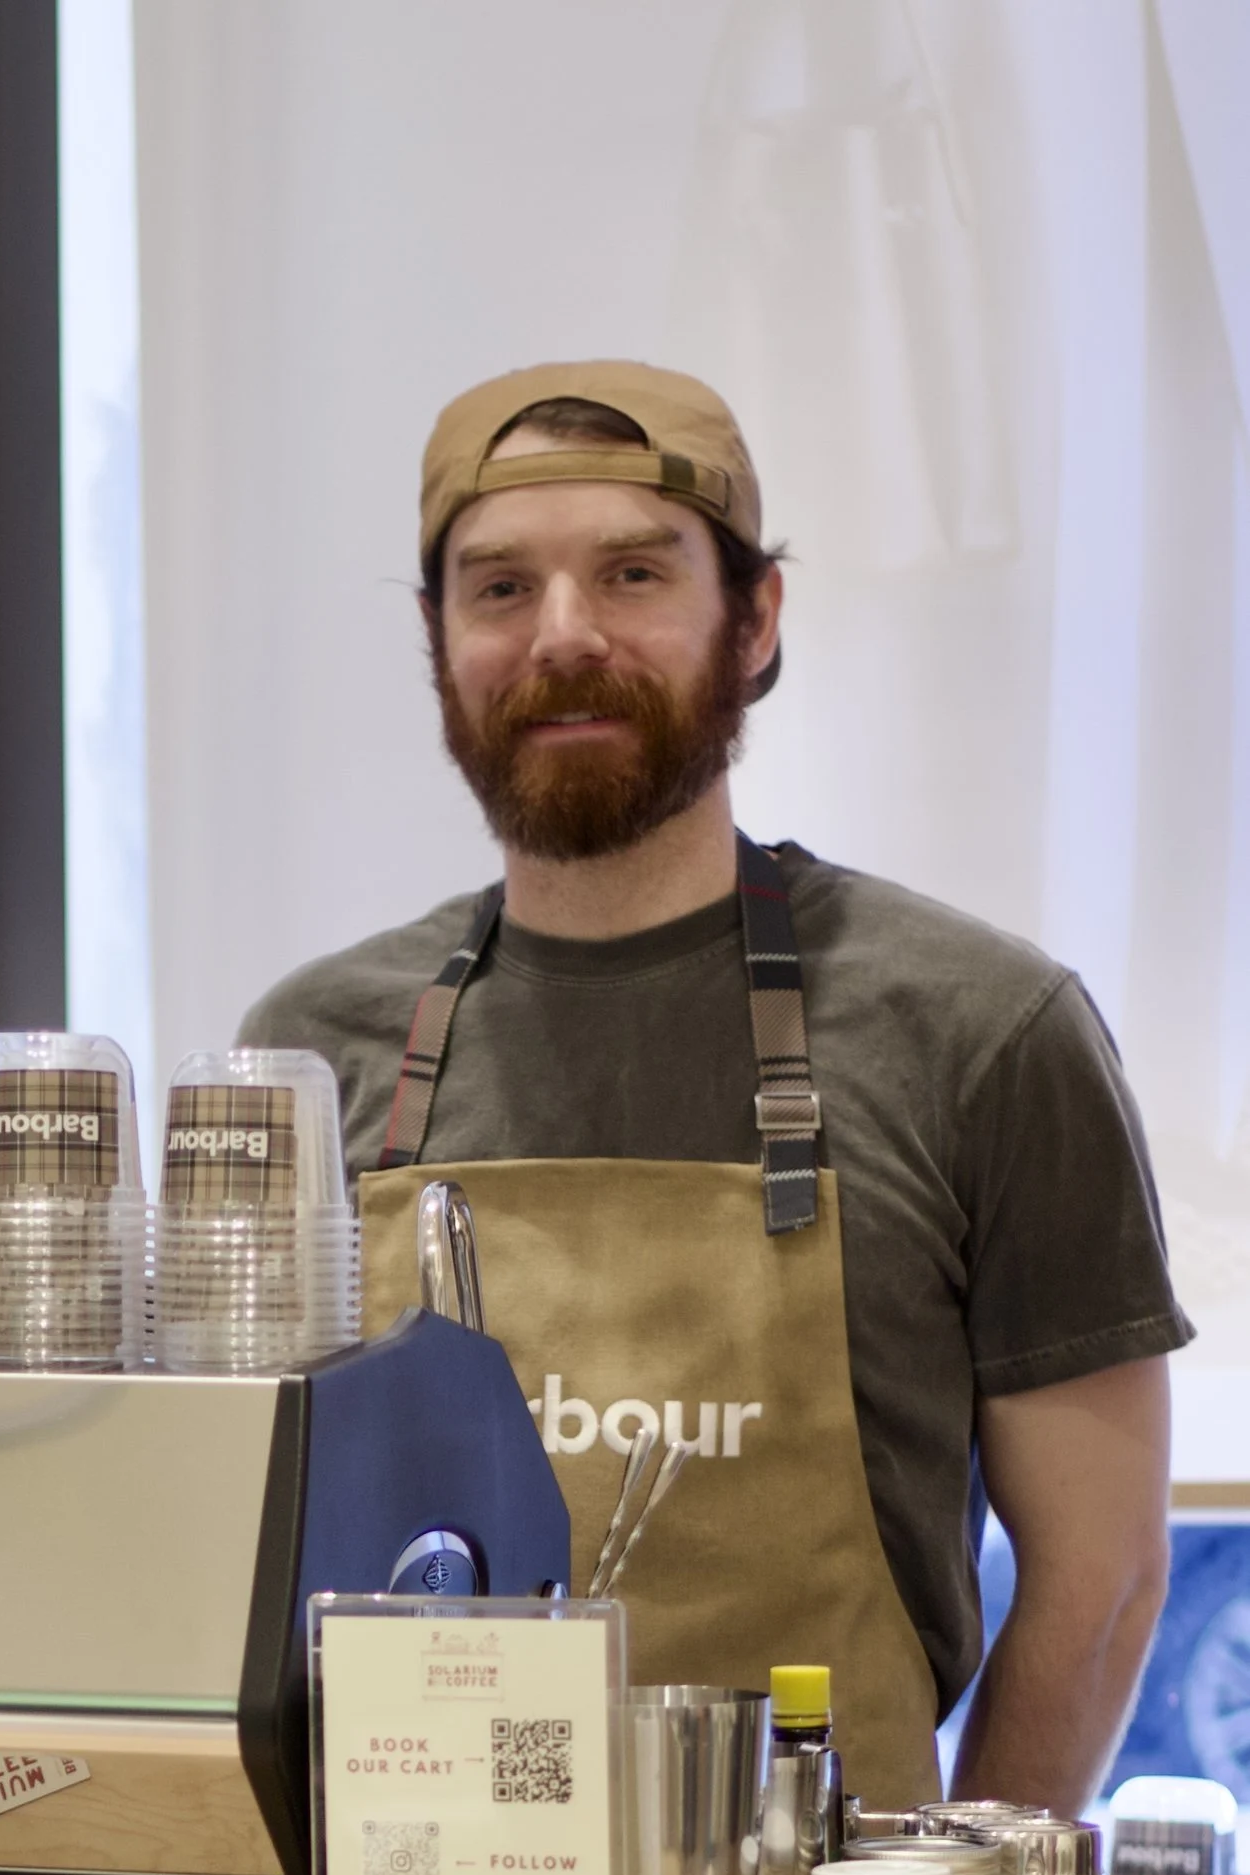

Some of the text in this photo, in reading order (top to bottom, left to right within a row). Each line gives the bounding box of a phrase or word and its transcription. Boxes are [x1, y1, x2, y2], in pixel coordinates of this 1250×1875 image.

[168, 1129, 269, 1158] Barbour
[527, 1374, 762, 1457] bour
[428, 1664, 498, 1676] SOLARIUM
[445, 1676, 497, 1687] COFFEE
[369, 1737, 429, 1753] BOOK
[346, 1758, 454, 1775] OUR CART
[490, 1854, 578, 1871] FOLLOW
